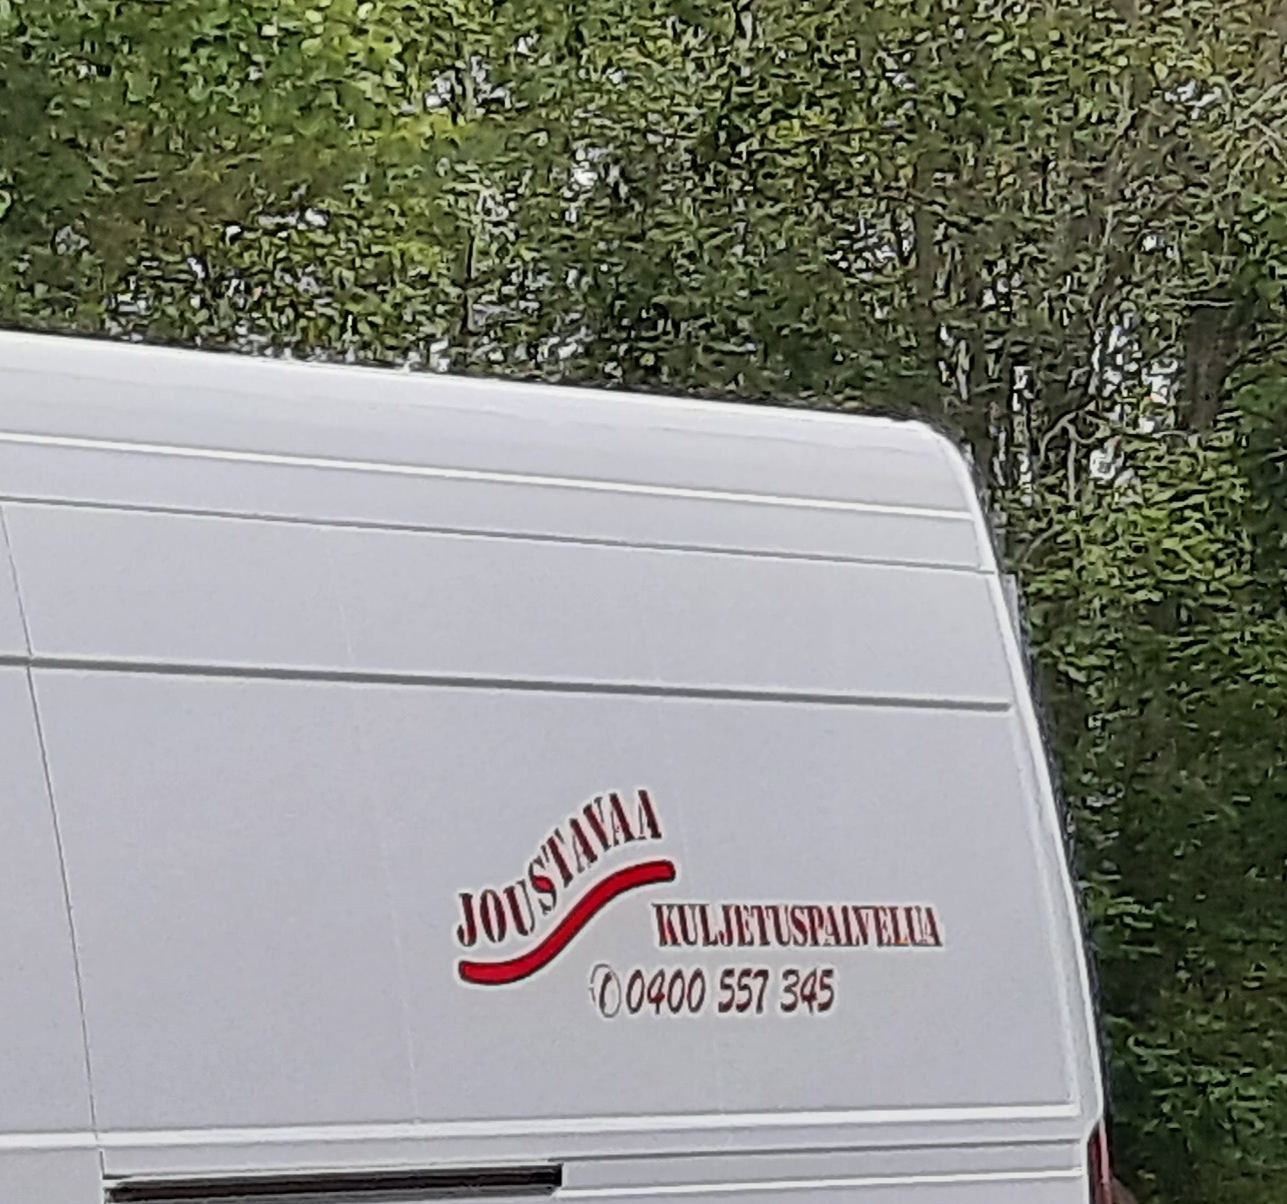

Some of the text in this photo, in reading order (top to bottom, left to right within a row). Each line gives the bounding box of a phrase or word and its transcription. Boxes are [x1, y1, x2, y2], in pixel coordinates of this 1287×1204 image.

[456, 789, 663, 947] JOUSTAVAA
[626, 968, 835, 1014] 0400 557 345
